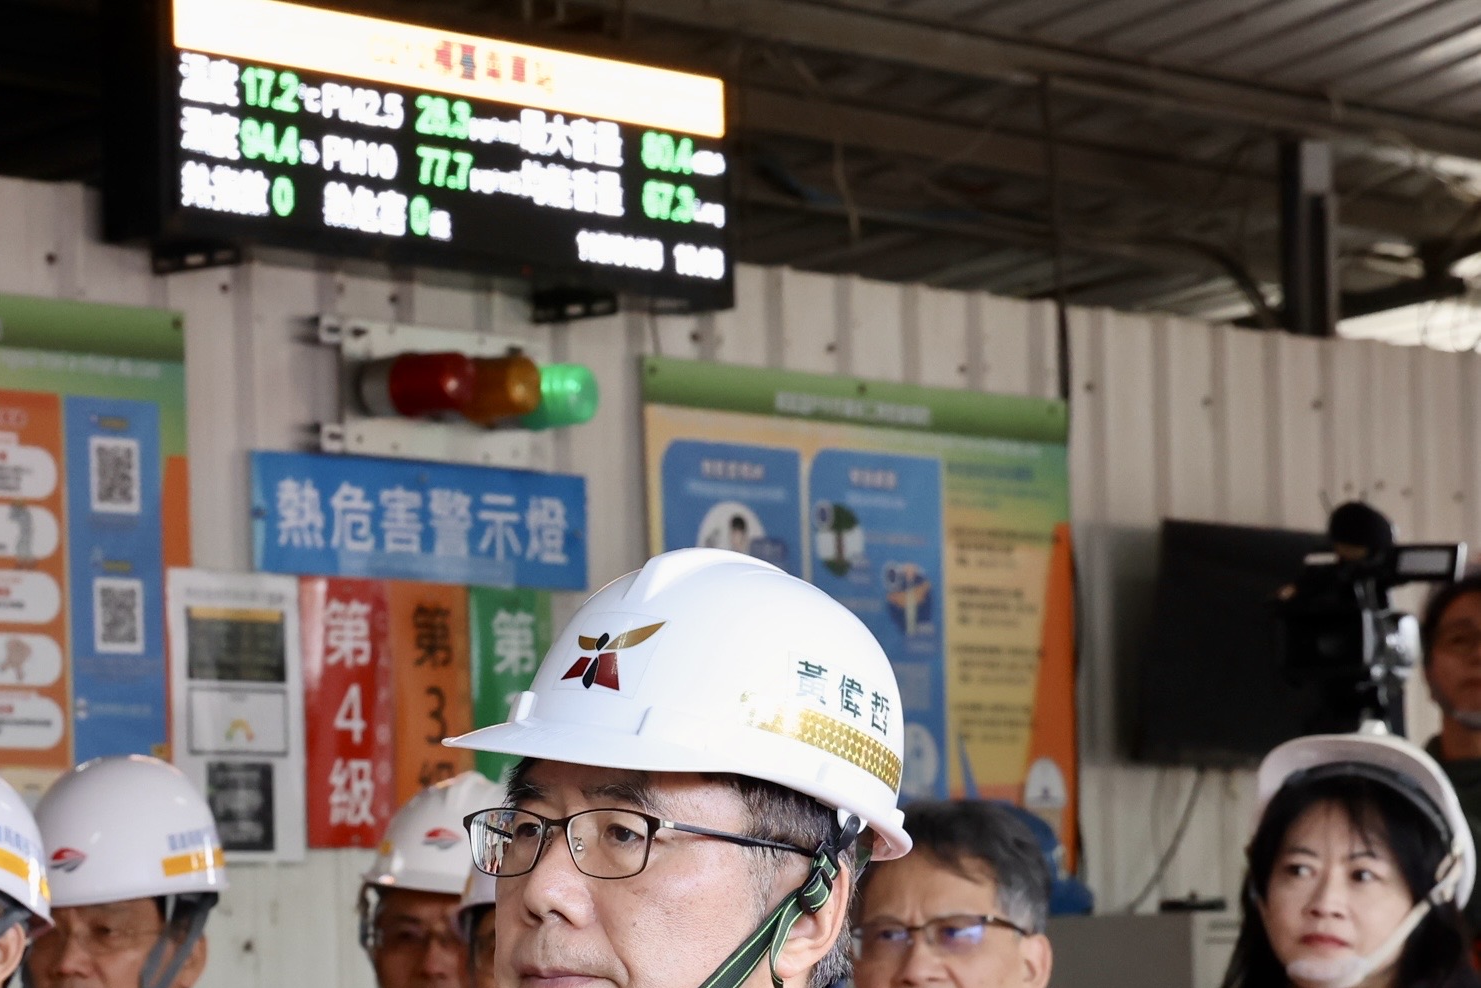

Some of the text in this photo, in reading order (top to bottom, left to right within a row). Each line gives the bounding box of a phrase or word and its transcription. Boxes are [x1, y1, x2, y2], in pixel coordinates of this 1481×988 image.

[240, 66, 300, 113] 17.2
[321, 82, 405, 130] PM2.5
[239, 117, 300, 165] 94.4
[321, 134, 399, 180] PM10
[416, 145, 474, 190] 77.7
[272, 176, 296, 217] 0
[275, 476, 570, 566] 熱危害警示燈
[323, 598, 376, 828] 第4級
[796, 660, 890, 737] 黃偉哲
